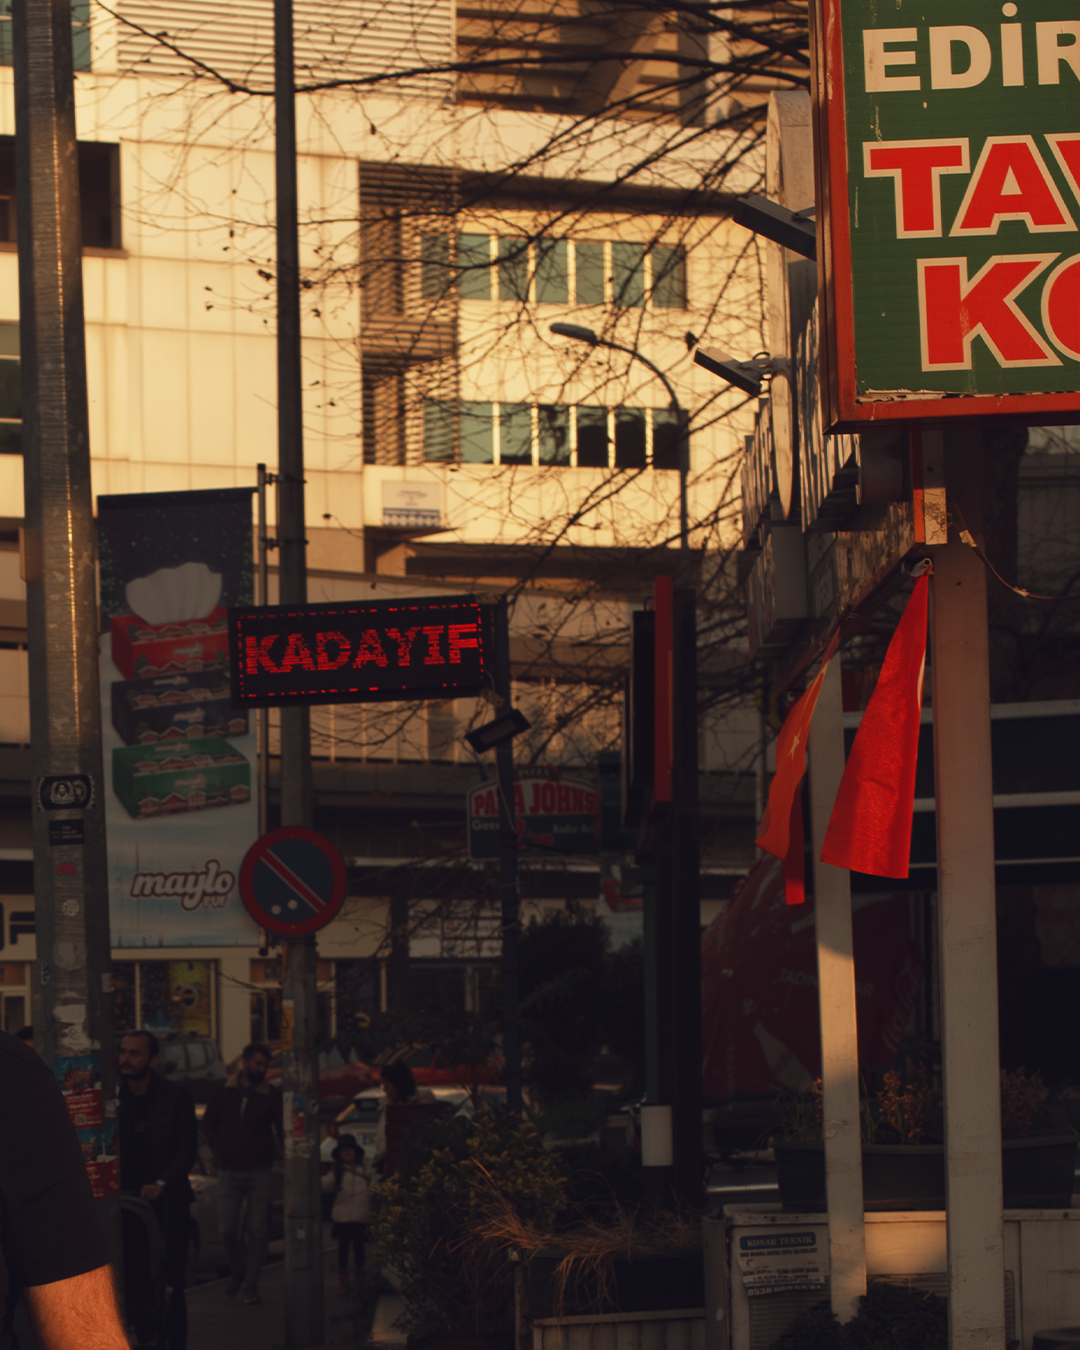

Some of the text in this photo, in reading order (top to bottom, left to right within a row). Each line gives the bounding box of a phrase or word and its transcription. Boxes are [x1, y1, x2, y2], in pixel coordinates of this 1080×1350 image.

[862, 132, 1080, 239] TA
[245, 623, 479, 675] KADAYIF
[474, 784, 526, 816] PAA
[130, 859, 236, 911] maylo
[747, 1235, 813, 1247] KONAK TEKNİK
